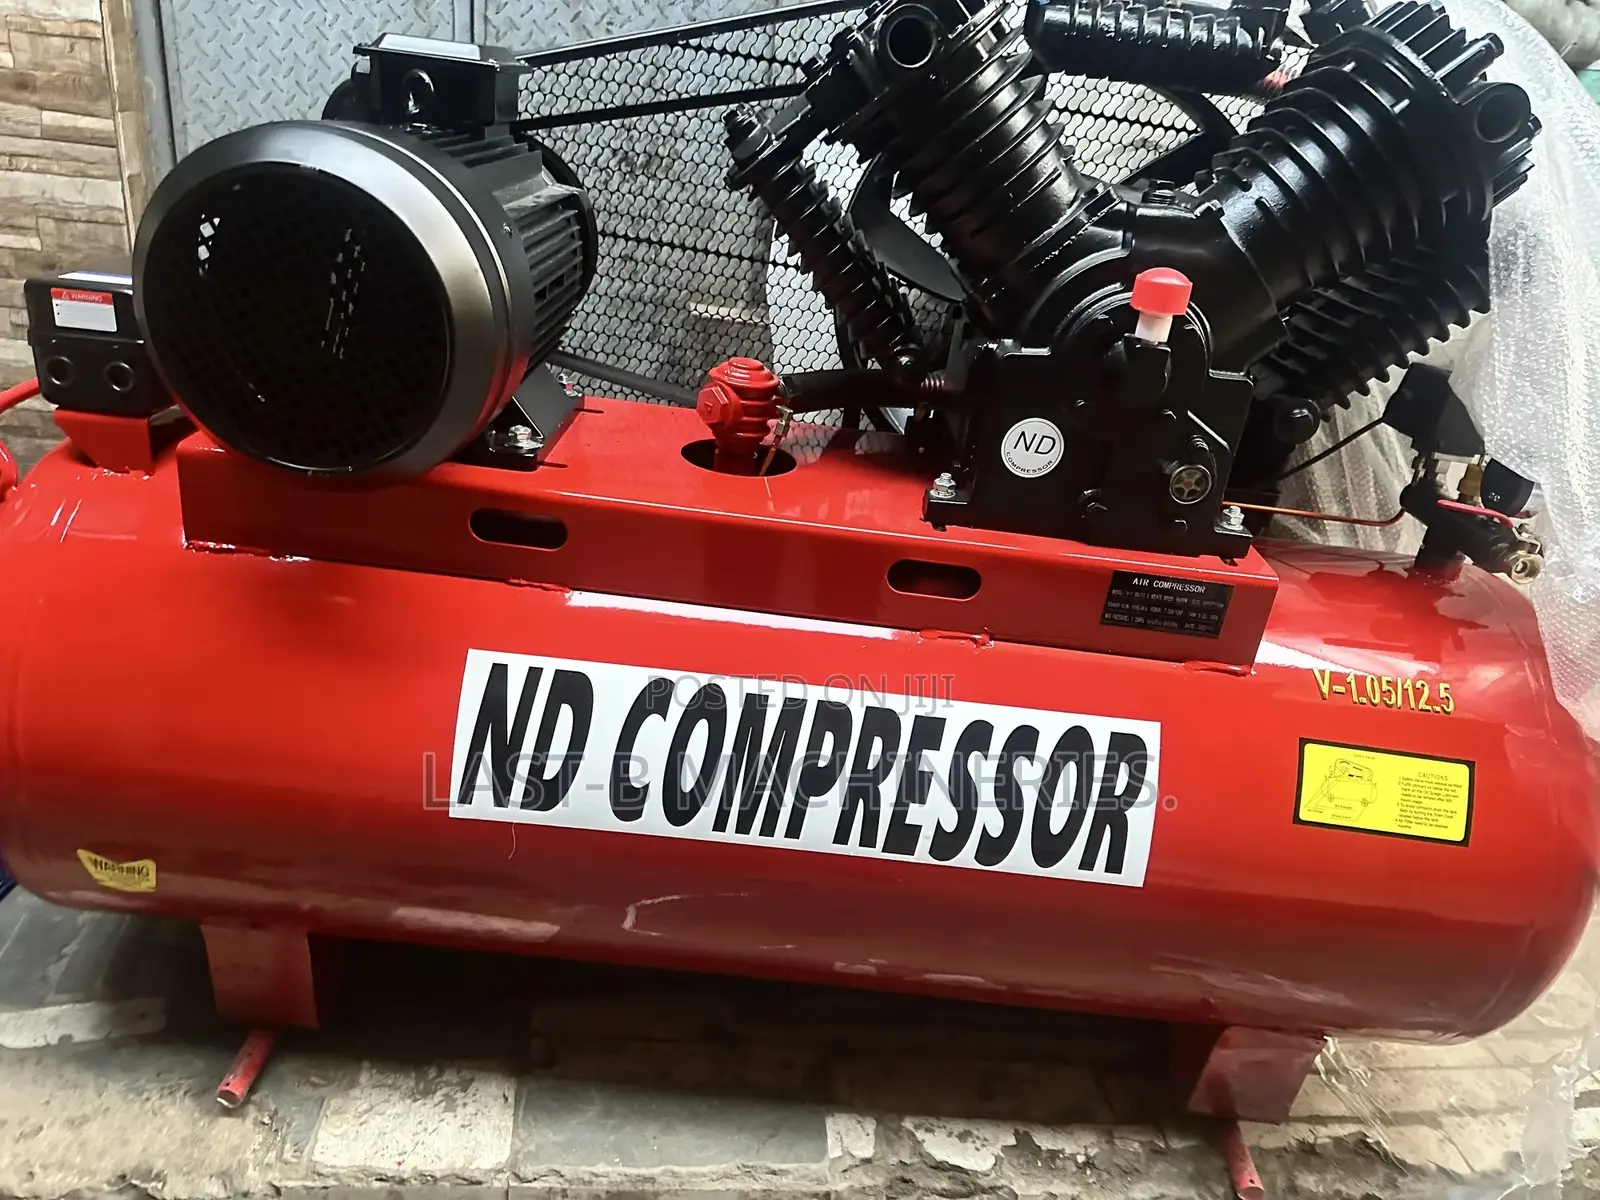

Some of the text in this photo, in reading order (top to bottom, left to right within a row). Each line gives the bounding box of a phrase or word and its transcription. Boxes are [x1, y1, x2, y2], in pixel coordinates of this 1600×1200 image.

[1013, 431, 1056, 455] ND
[1006, 451, 1053, 473] COMPRESSOR
[1132, 577, 1206, 594] AIR COMPRESSOR
[457, 663, 1147, 875] ND COMPRESSOR
[1418, 772, 1448, 781] CAUTIONS
